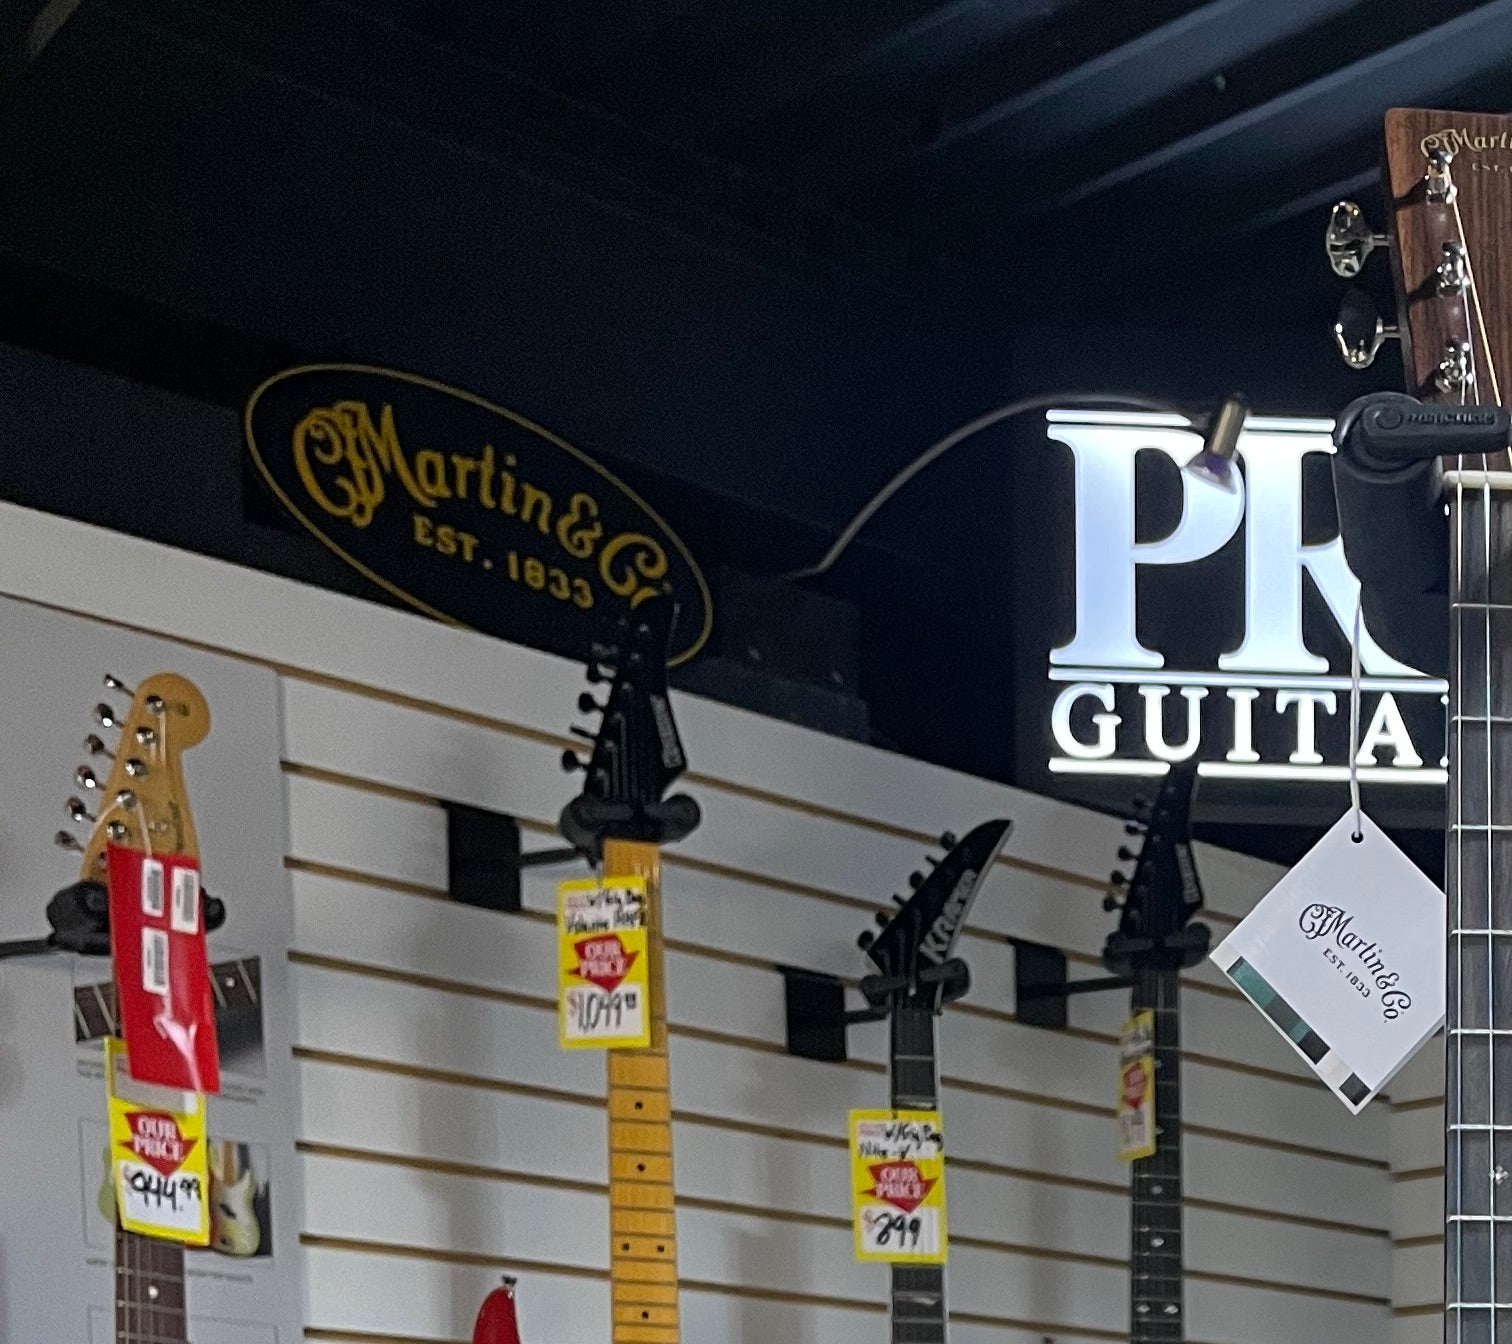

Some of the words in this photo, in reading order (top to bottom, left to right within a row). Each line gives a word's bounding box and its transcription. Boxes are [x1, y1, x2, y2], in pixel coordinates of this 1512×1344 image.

[413, 513, 494, 570] EST.
[506, 549, 595, 610] 1833
[1051, 683, 1450, 767] GUITA
[1345, 971, 1372, 999] 1833
[138, 1115, 177, 1139] OUR
[133, 1137, 184, 1162] PRICE
